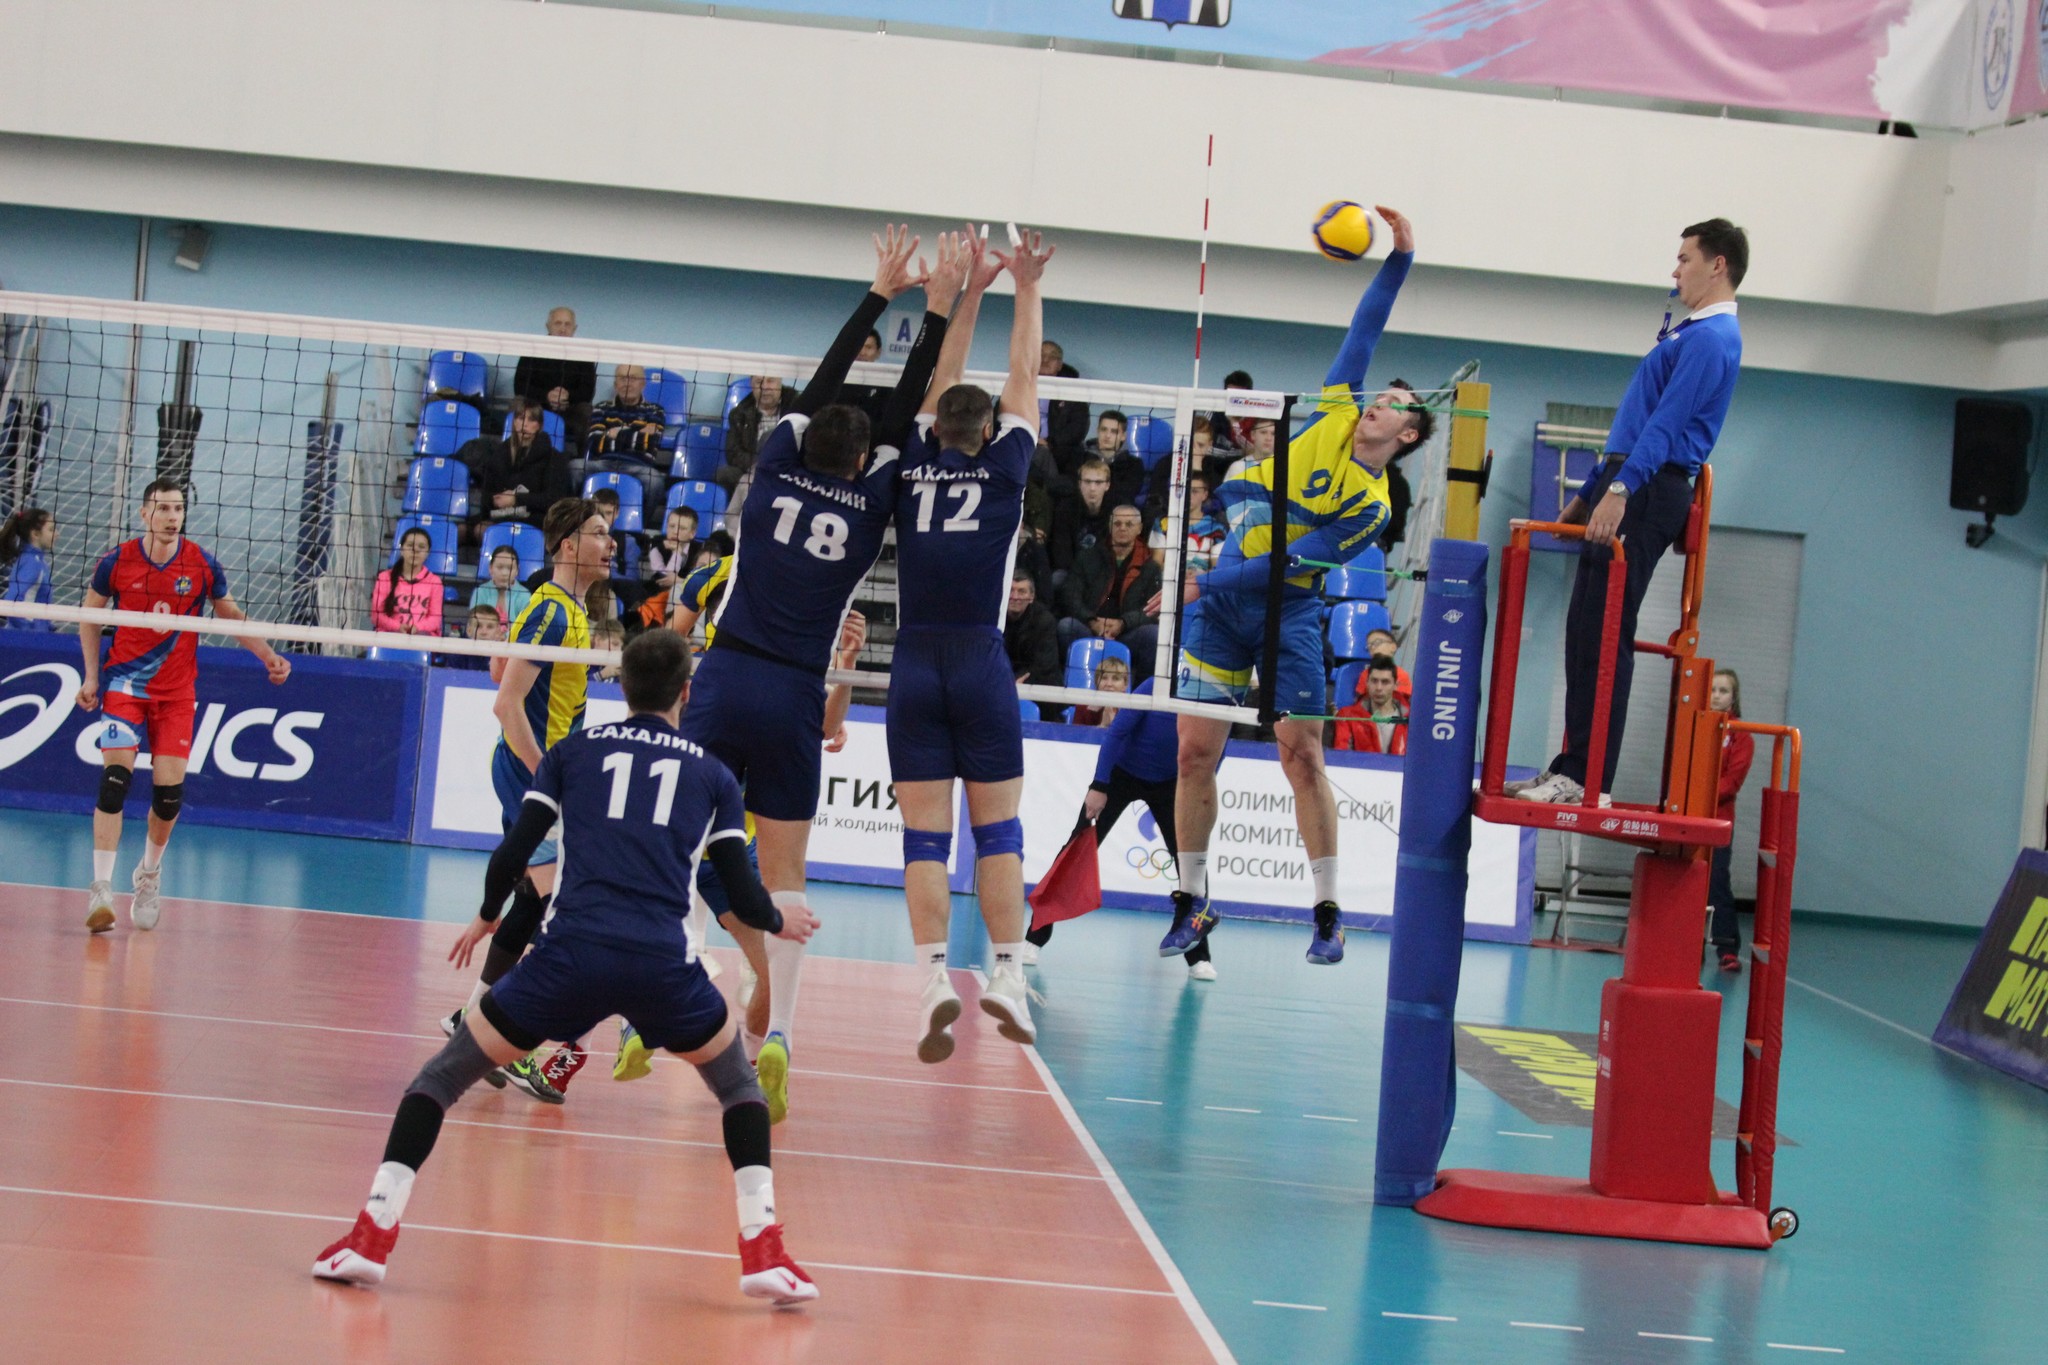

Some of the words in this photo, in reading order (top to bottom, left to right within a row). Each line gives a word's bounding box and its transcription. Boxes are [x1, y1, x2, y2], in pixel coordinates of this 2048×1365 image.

[1300, 468, 1333, 499] 9
[911, 482, 982, 533] 12
[771, 496, 849, 562] 18
[1181, 667, 1190, 688] 9
[1432, 640, 1462, 741] JINLING
[108, 723, 118, 740] 8
[586, 725, 704, 758] САХАЛИН
[602, 751, 682, 827] 11
[827, 776, 898, 810] ГИЯ
[834, 817, 905, 834] холдин
[1219, 823, 1305, 848] КОМИТЕ
[1217, 855, 1305, 881] РОССИИ
[1983, 959, 2048, 1037] МАТ
